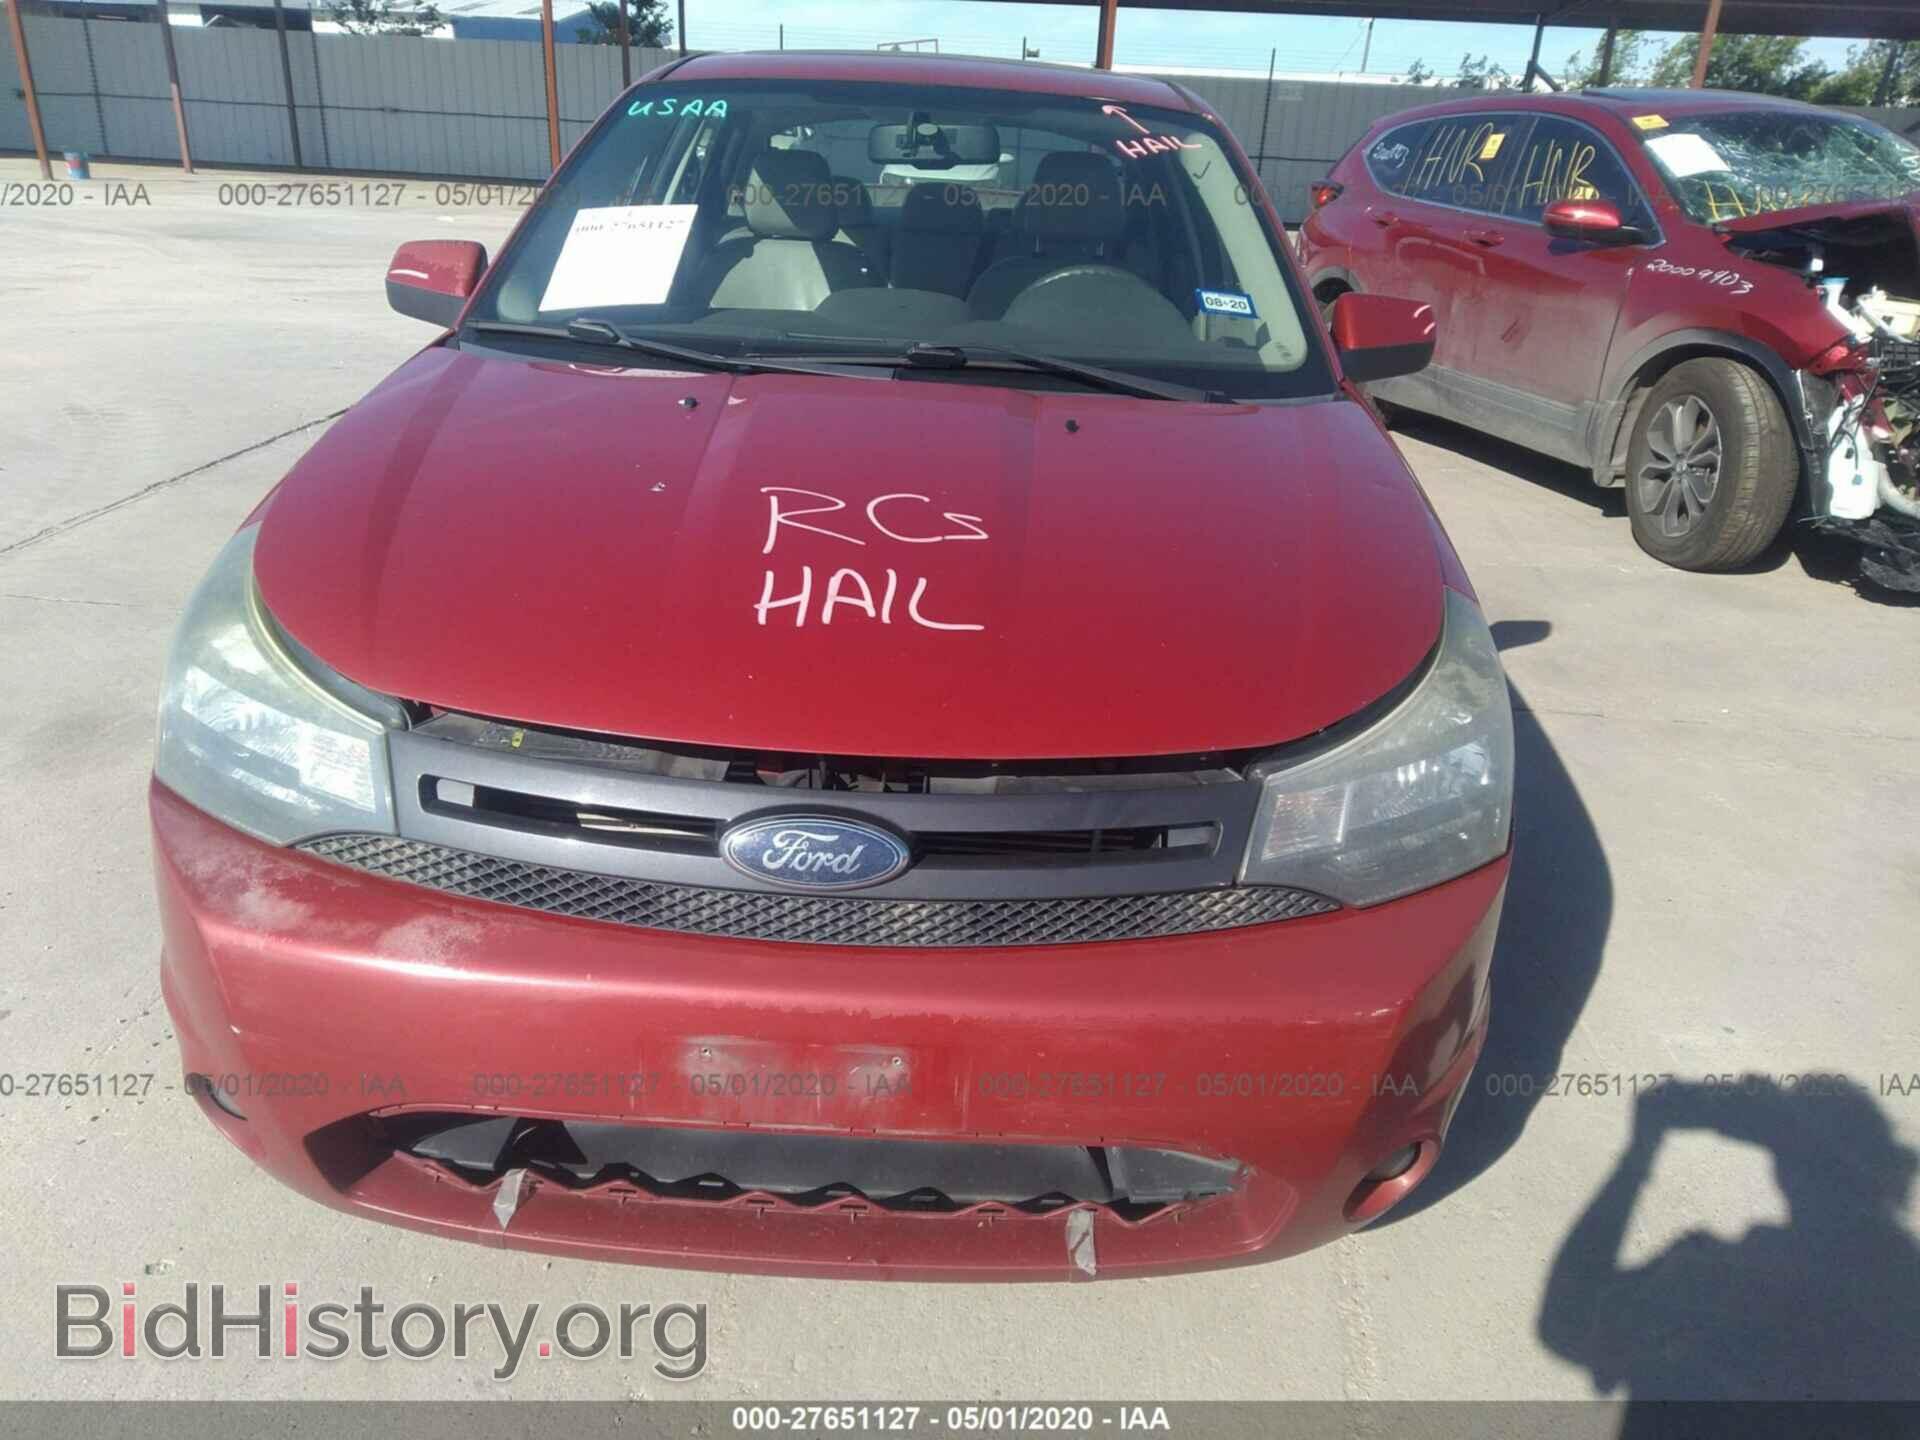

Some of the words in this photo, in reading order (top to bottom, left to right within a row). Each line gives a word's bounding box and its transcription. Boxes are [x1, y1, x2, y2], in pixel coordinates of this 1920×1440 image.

[627, 98, 728, 118] USAA
[1115, 135, 1202, 159] HAIL
[1205, 296, 1248, 310] 08-20
[753, 565, 986, 631] HAIL
[762, 829, 869, 875] Ford
